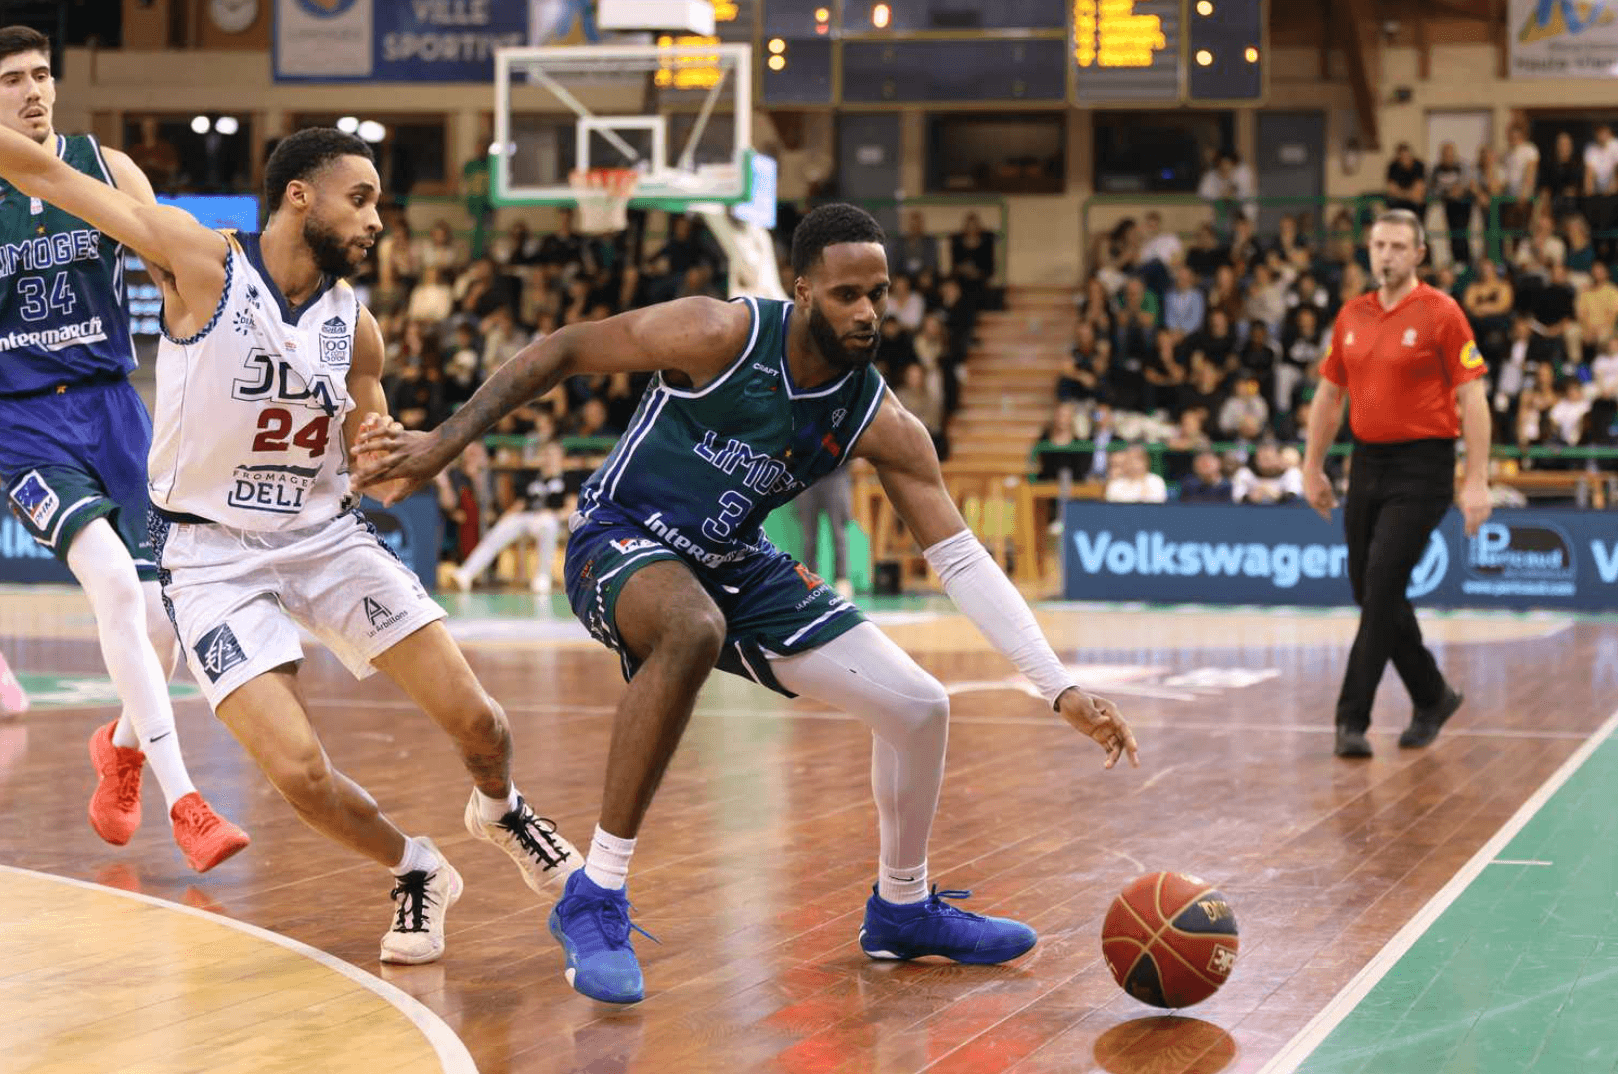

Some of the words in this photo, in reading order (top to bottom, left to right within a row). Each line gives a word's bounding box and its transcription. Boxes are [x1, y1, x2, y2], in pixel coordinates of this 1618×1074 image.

[0, 230, 100, 278] IMOGES
[17, 270, 76, 322] 34
[231, 347, 346, 417] JDA
[752, 362, 779, 377] CRAFT
[252, 408, 330, 458] 24
[235, 479, 305, 507] DELI
[701, 490, 753, 545] 3
[1072, 530, 1350, 588] Volkswagen
